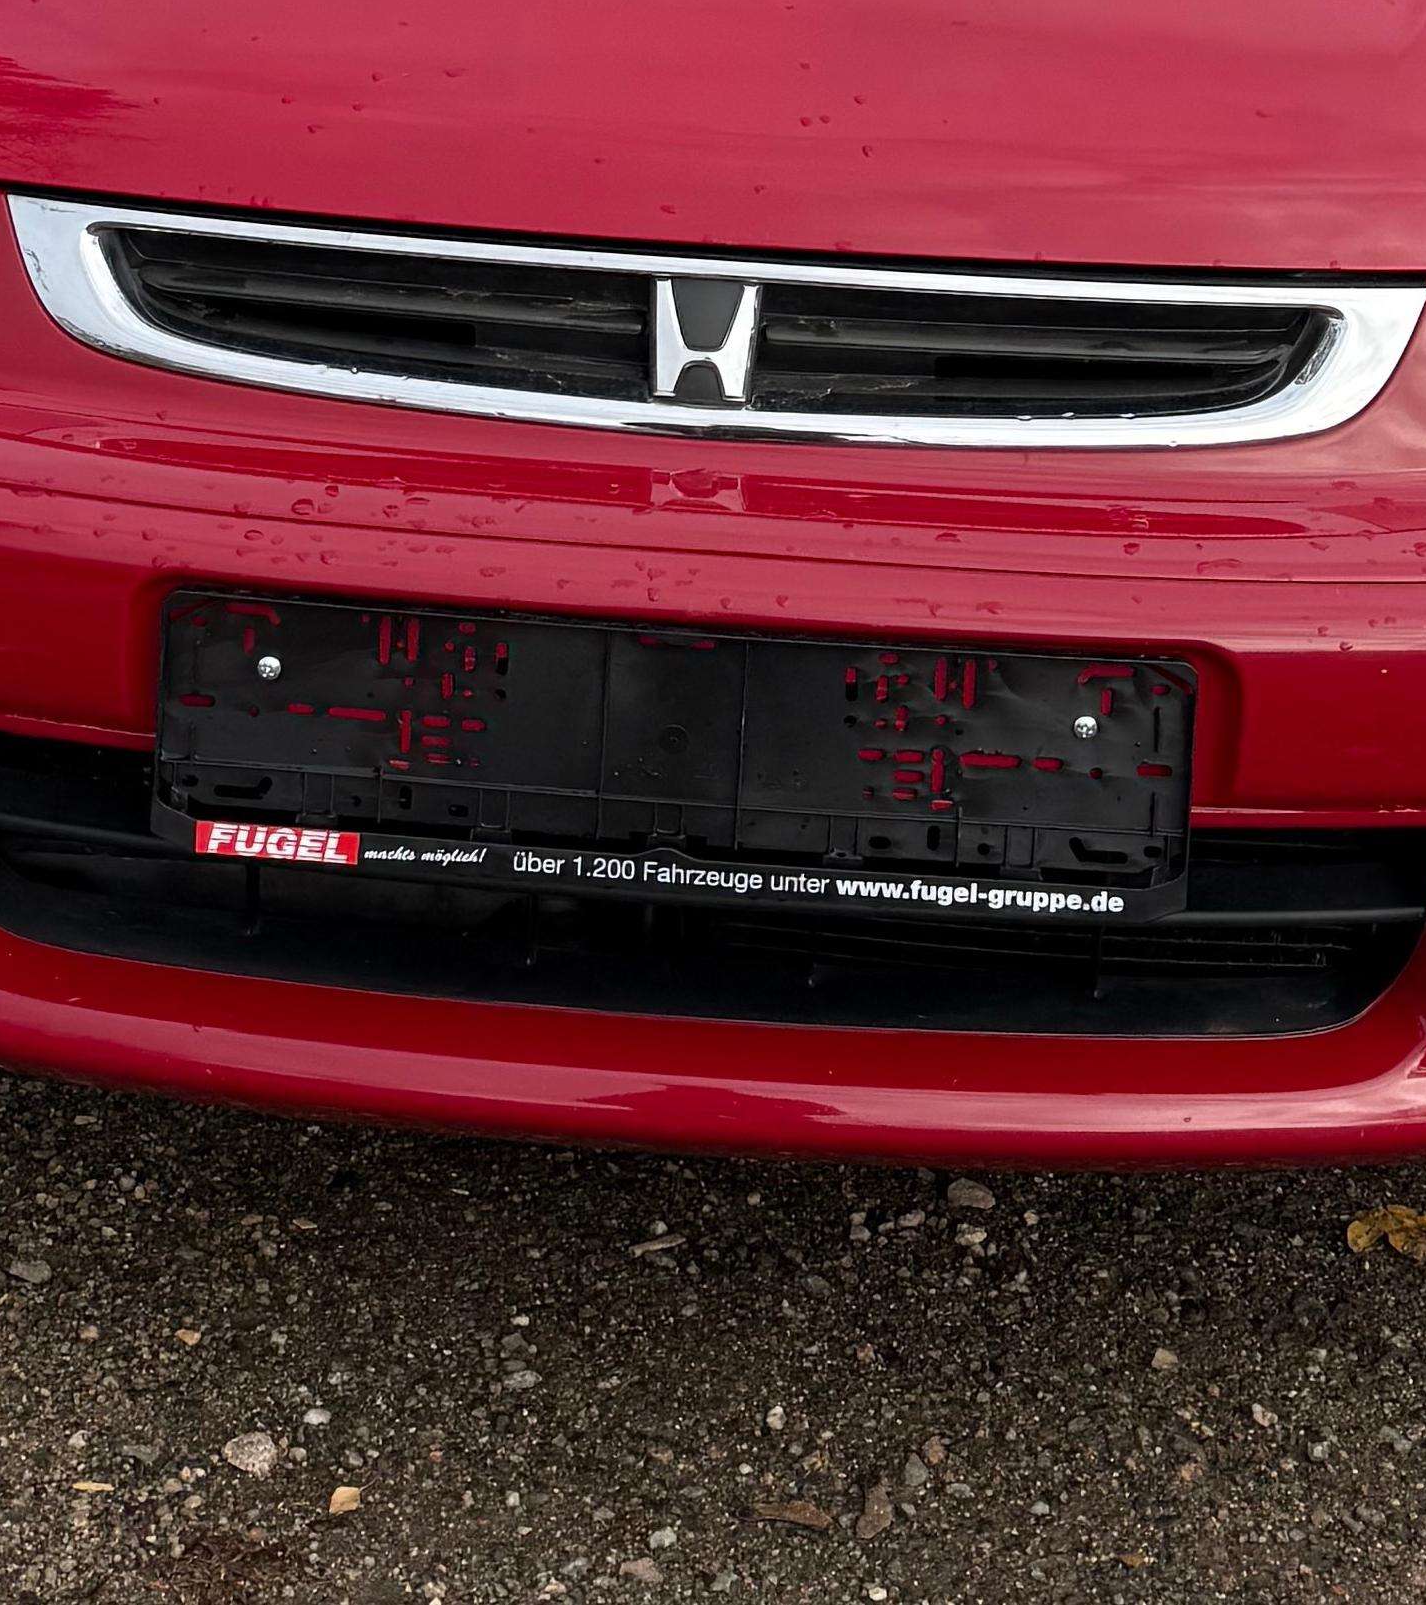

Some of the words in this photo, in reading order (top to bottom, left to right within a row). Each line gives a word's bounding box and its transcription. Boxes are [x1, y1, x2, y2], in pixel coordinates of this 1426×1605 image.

[207, 823, 349, 863] FUGEL
[364, 847, 415, 860] machts
[421, 848, 487, 866] möglich!
[514, 852, 565, 874] über
[573, 857, 635, 879] 1.200
[644, 862, 762, 893] Fahrzeuge
[771, 874, 830, 893] unter
[836, 880, 1124, 912] www.fugel-gruppe.de
